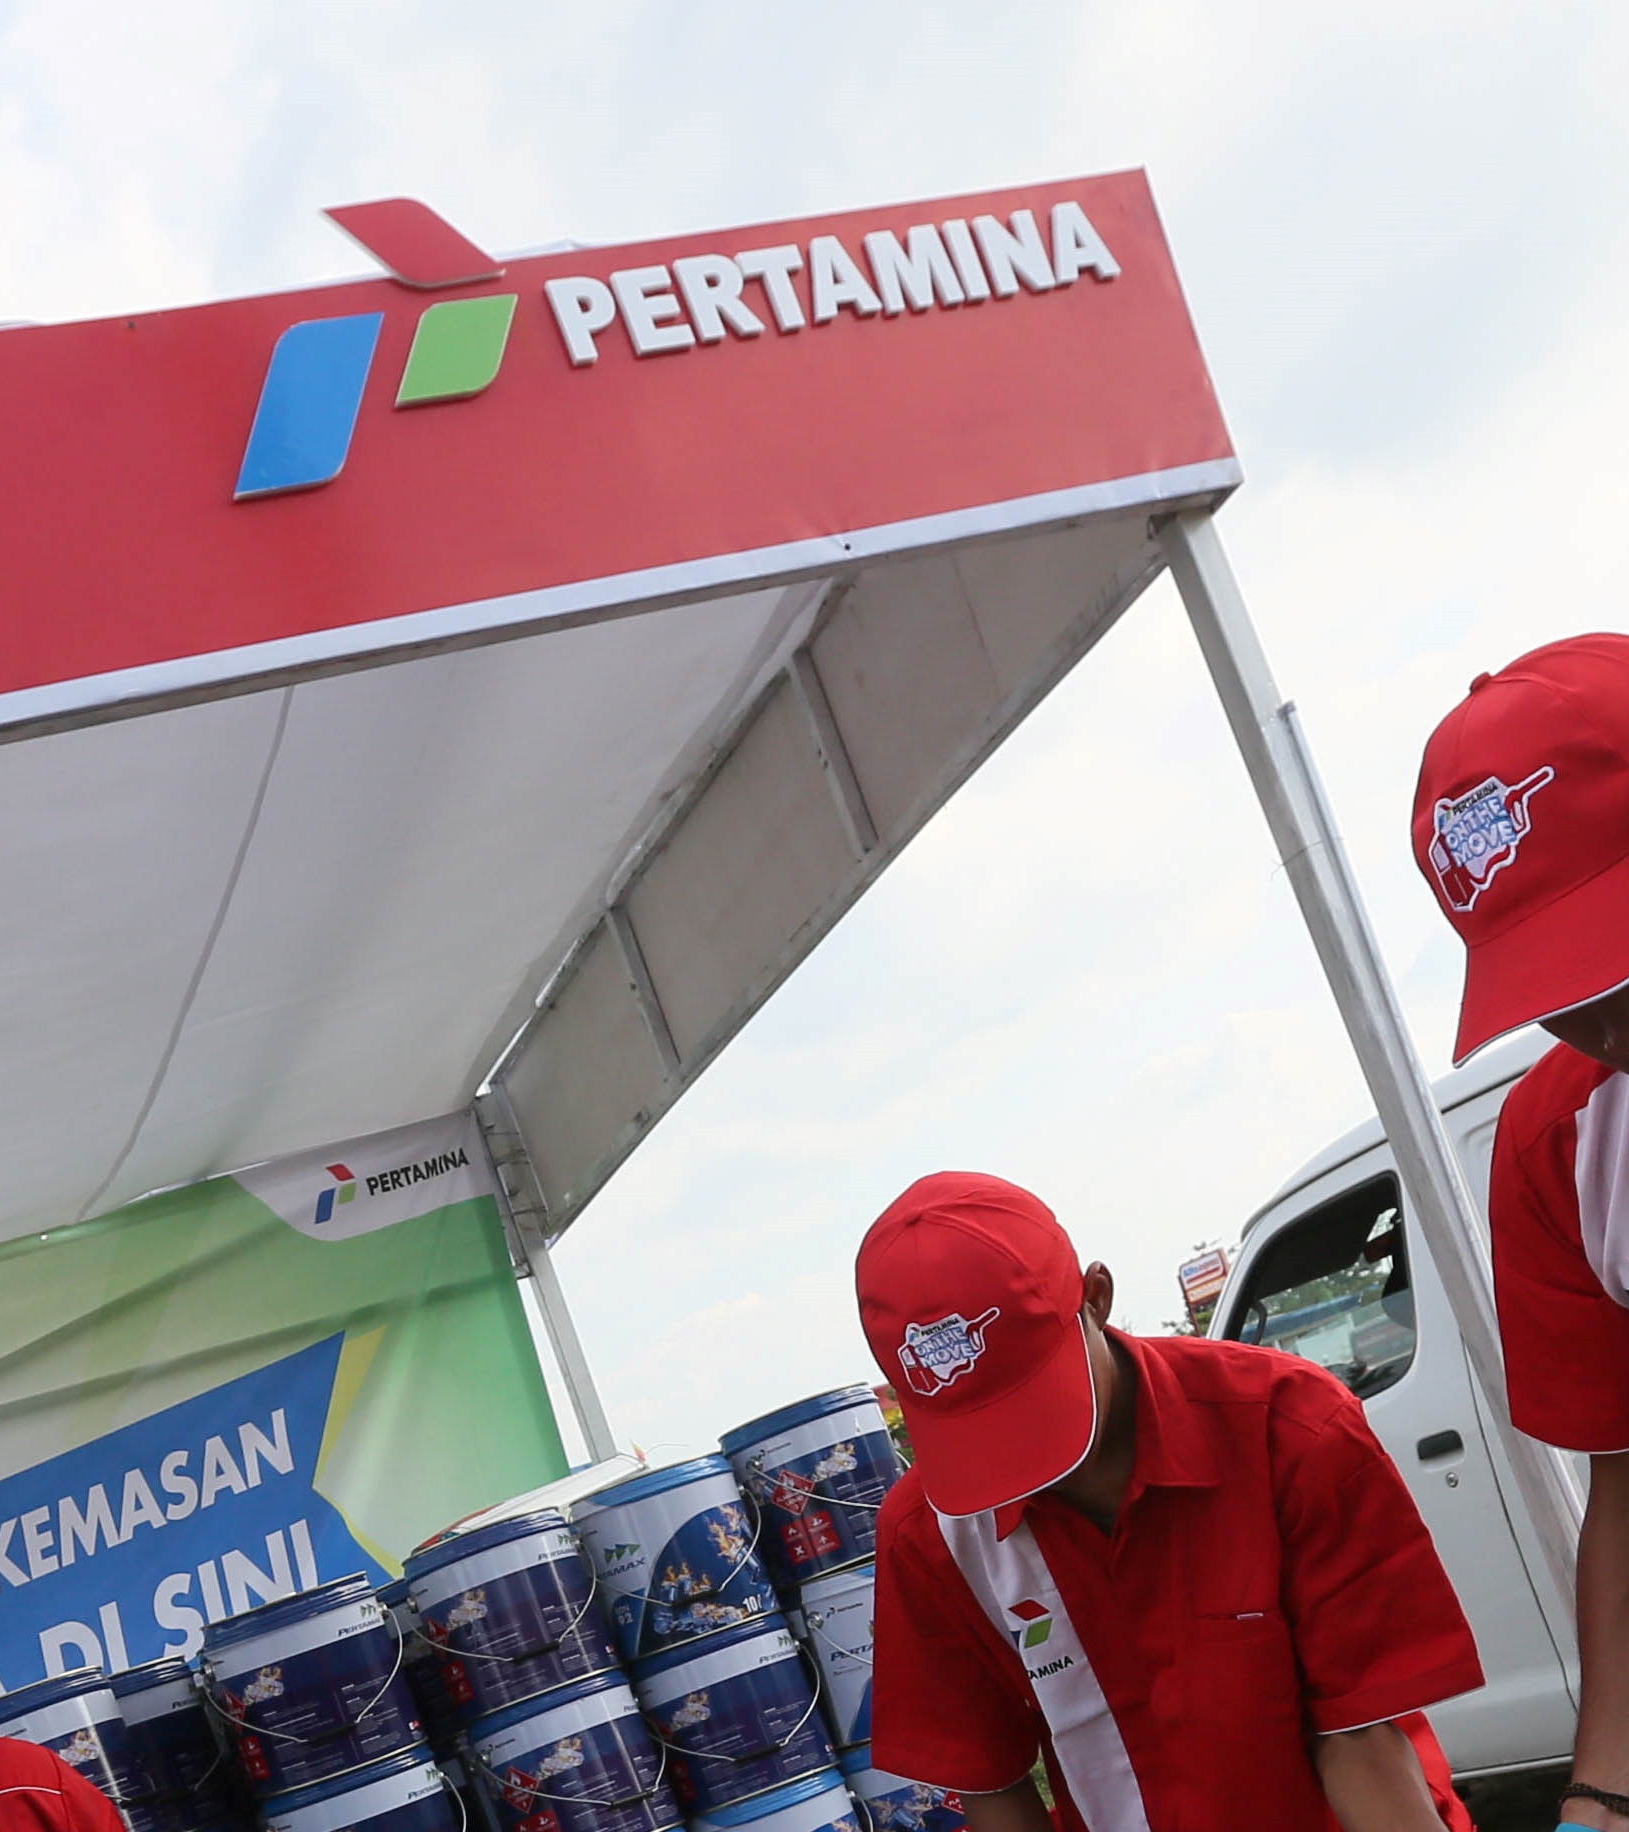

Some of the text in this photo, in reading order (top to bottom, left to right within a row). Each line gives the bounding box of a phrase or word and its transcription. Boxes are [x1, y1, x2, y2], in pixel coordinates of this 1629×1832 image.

[546, 201, 1121, 366] PERTAMINA
[1451, 819, 1517, 868] MOVE
[366, 1147, 470, 1198] PERTAMINA
[918, 1342, 976, 1368] MOVE
[39, 1600, 130, 1680] DI
[153, 1519, 319, 1658] SINI
[1030, 1656, 1074, 1679] AMINA
